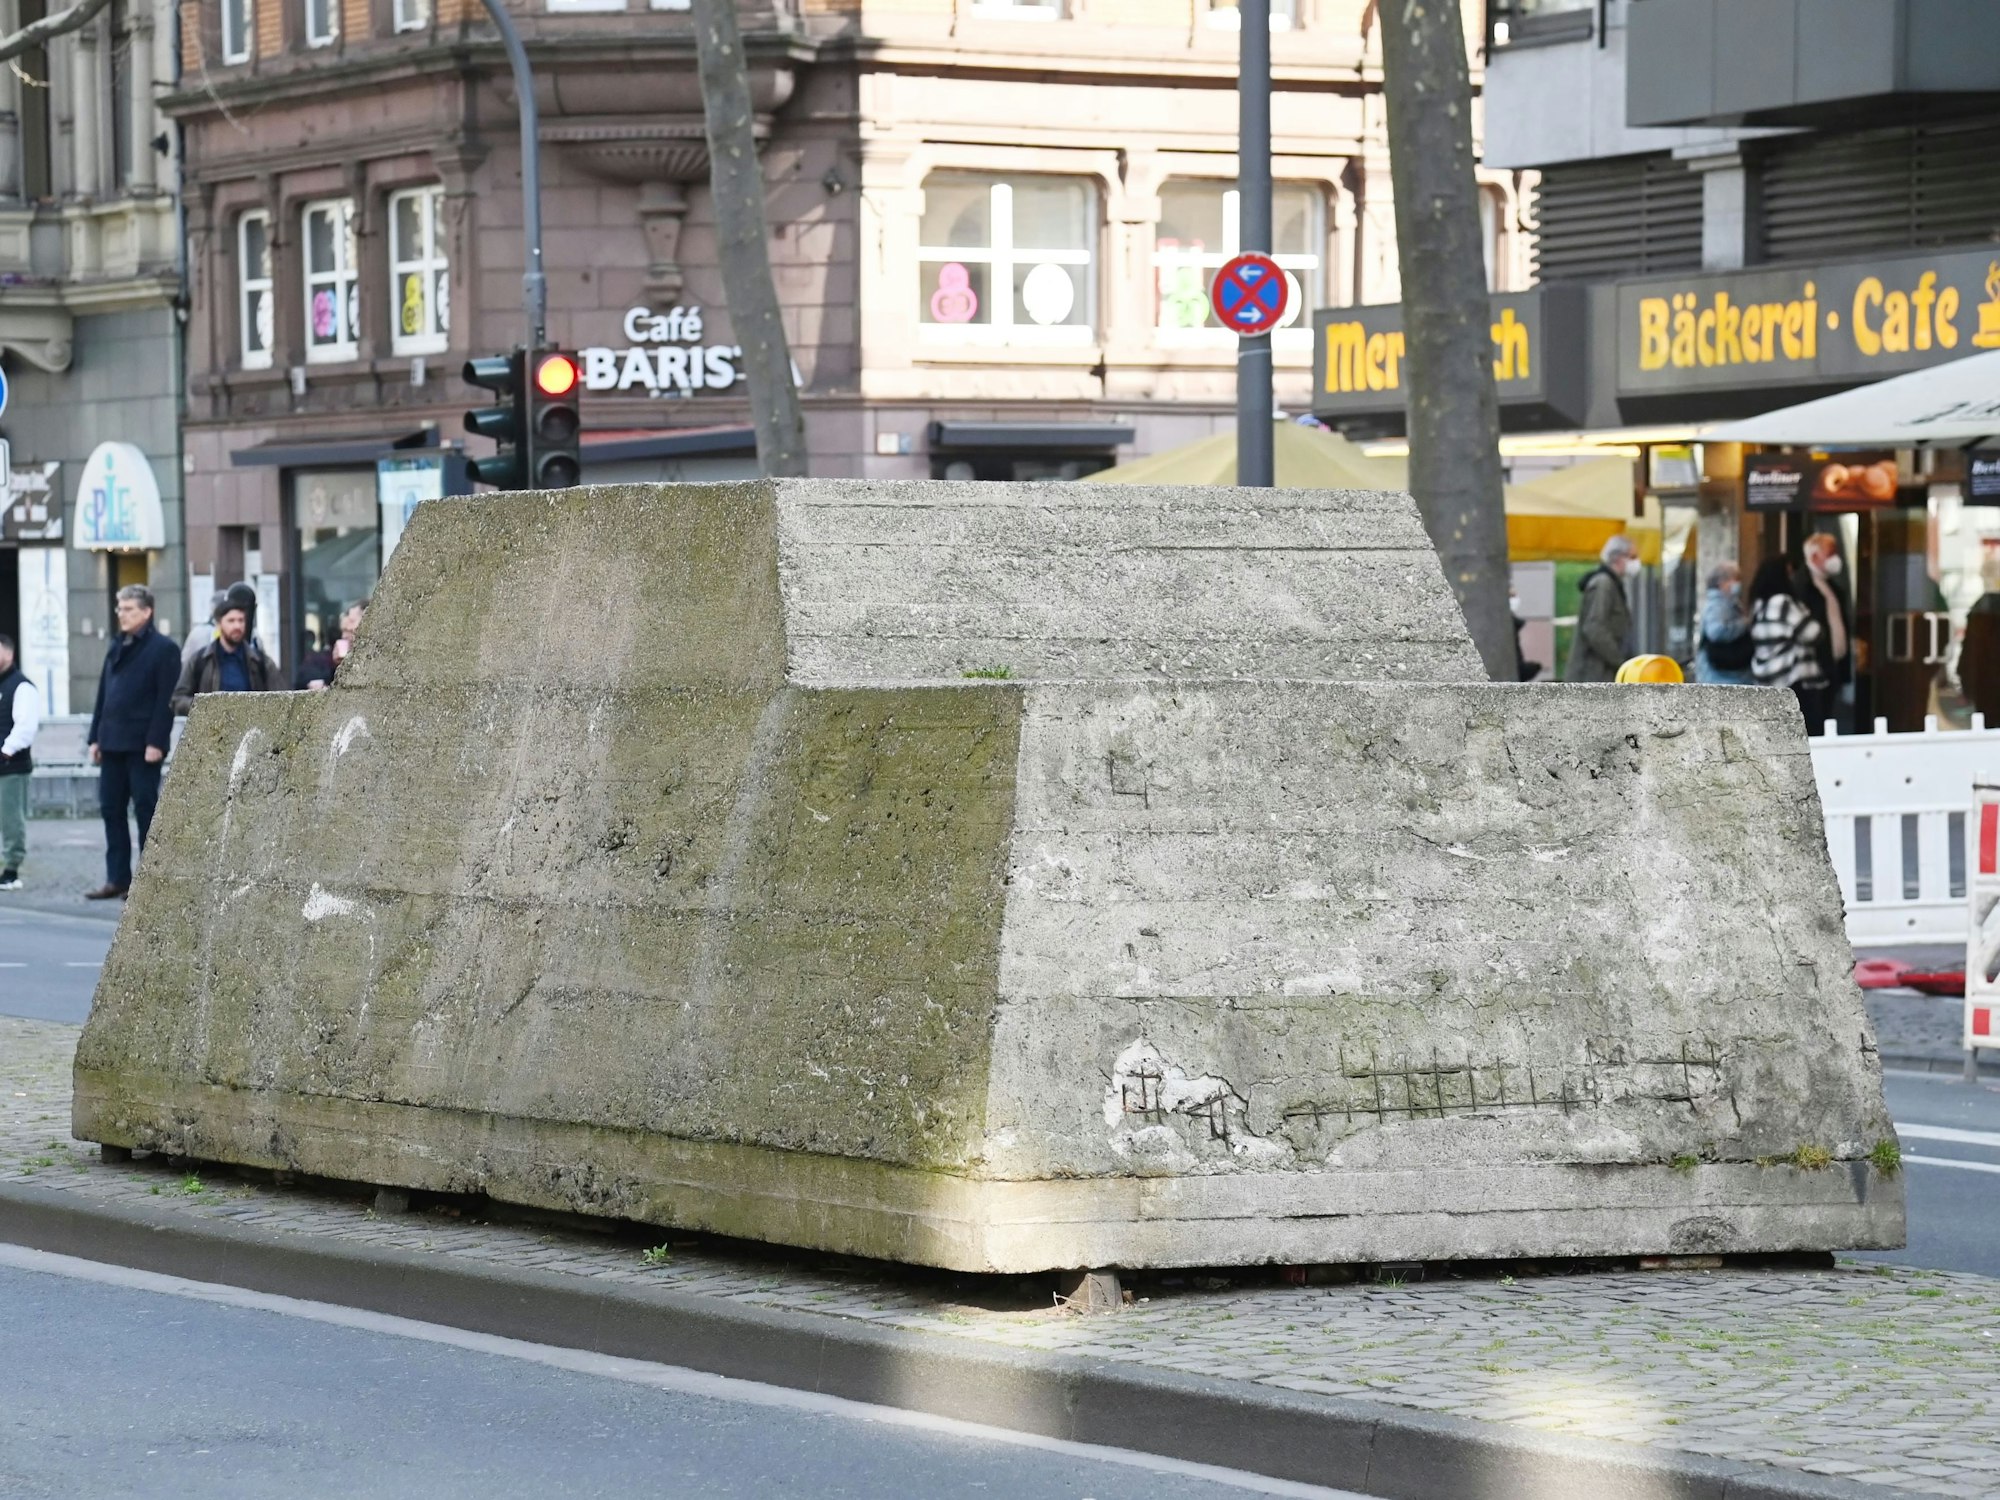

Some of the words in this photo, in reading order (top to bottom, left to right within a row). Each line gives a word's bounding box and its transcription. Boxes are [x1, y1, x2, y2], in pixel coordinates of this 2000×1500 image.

[623, 306, 702, 342] Café
[1639, 280, 1817, 371] Bäckerei
[1853, 270, 1959, 356] Cafe
